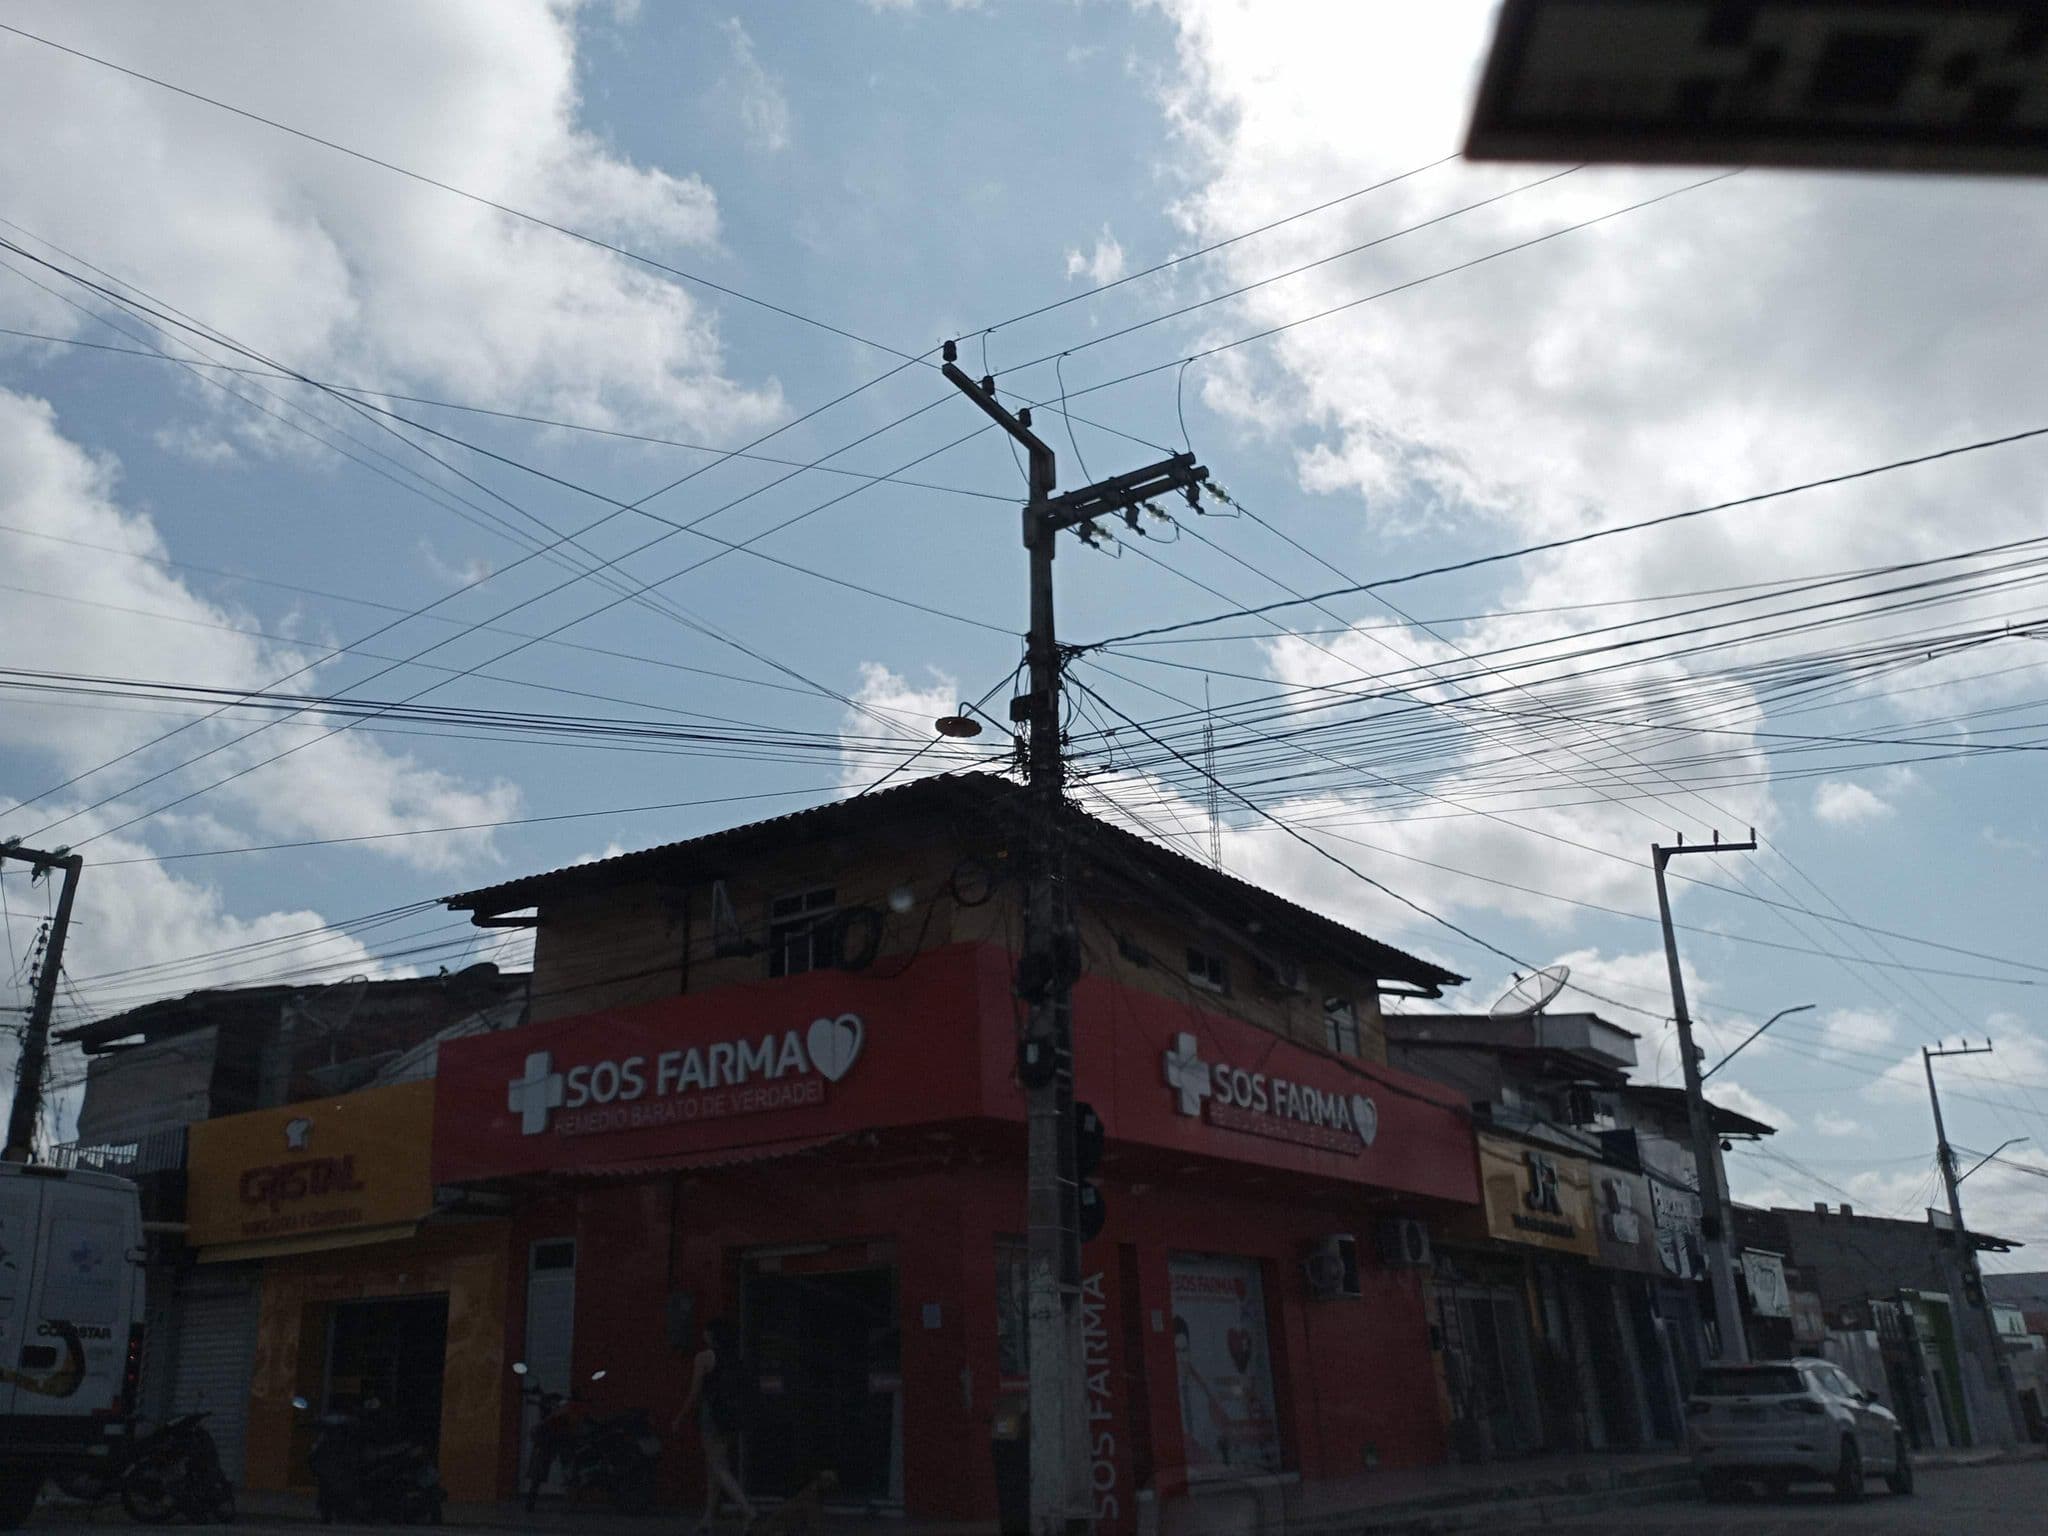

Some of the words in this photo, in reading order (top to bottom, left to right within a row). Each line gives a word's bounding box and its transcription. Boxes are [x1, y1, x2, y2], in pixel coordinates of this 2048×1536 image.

[565, 1055, 647, 1109] SOS
[656, 1031, 808, 1096] FARMA
[1213, 1063, 1268, 1111] SOS
[1272, 1077, 1354, 1133] FARMA
[631, 1097, 698, 1128] BARATO
[702, 1094, 726, 1117] DE
[1081, 1271, 1112, 1420] FARMA
[1091, 1431, 1119, 1520] SOS
